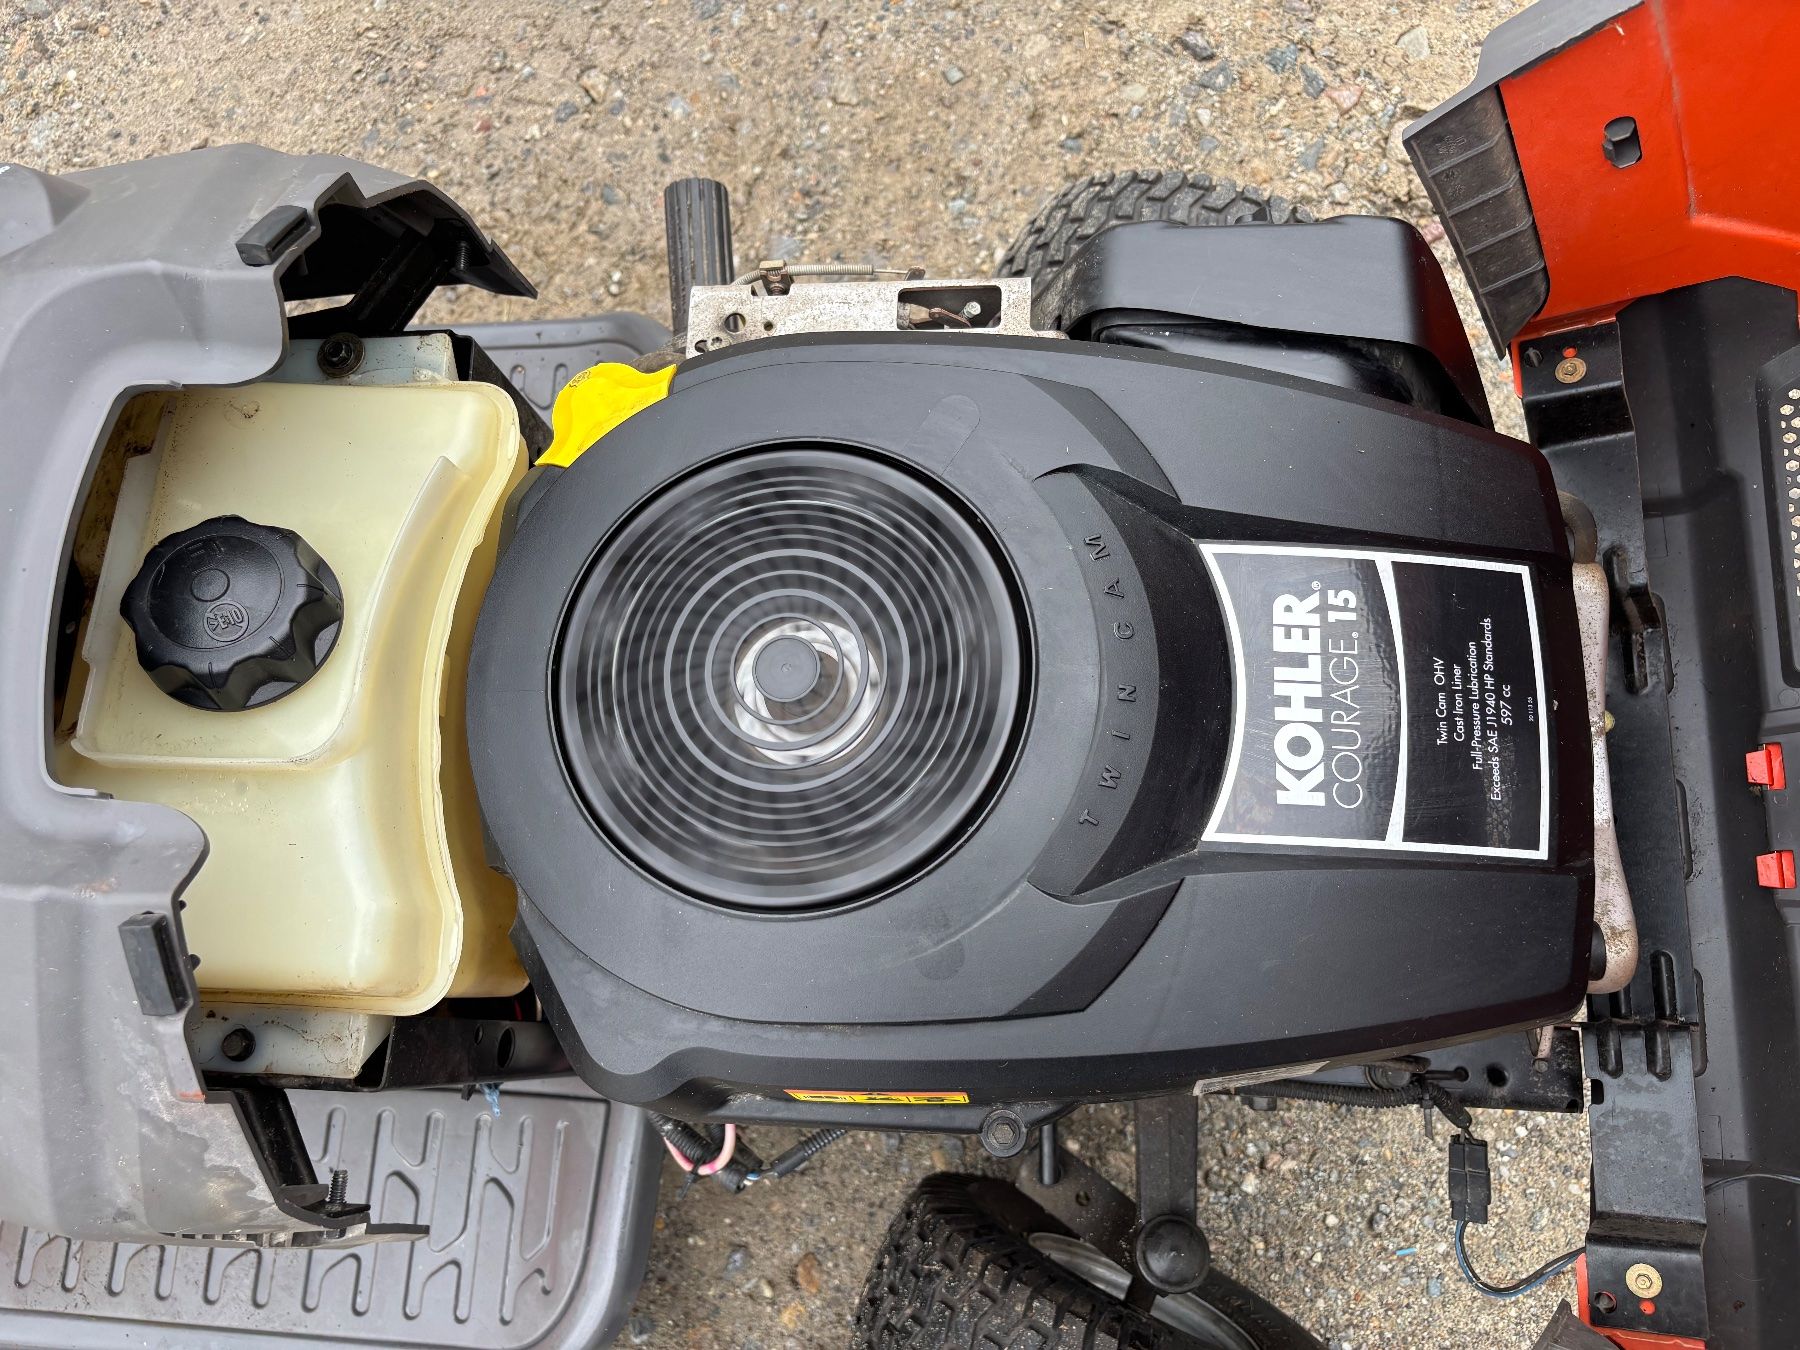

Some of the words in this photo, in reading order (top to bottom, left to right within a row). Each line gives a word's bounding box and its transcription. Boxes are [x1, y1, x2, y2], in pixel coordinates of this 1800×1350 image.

[1084, 534, 1134, 640] CAM
[1328, 589, 1357, 623] 15
[1481, 618, 1493, 670] Standards
[1433, 657, 1445, 685] OHV
[1451, 664, 1462, 690] Liner
[1467, 642, 1480, 699] Lubrication
[1484, 673, 1495, 689] HP
[1452, 694, 1463, 714] Iron
[1502, 685, 1511, 697] cc
[1435, 693, 1447, 718] Cam
[1485, 692, 1498, 727] J1940
[1501, 701, 1512, 726] 597
[1436, 721, 1448, 745] Twin
[1452, 716, 1465, 741] Cast
[1469, 702, 1483, 770] Full-Pressure
[1487, 730, 1499, 754] SAE
[1078, 683, 1136, 827] TWIN
[1489, 756, 1501, 800] Exceeds
